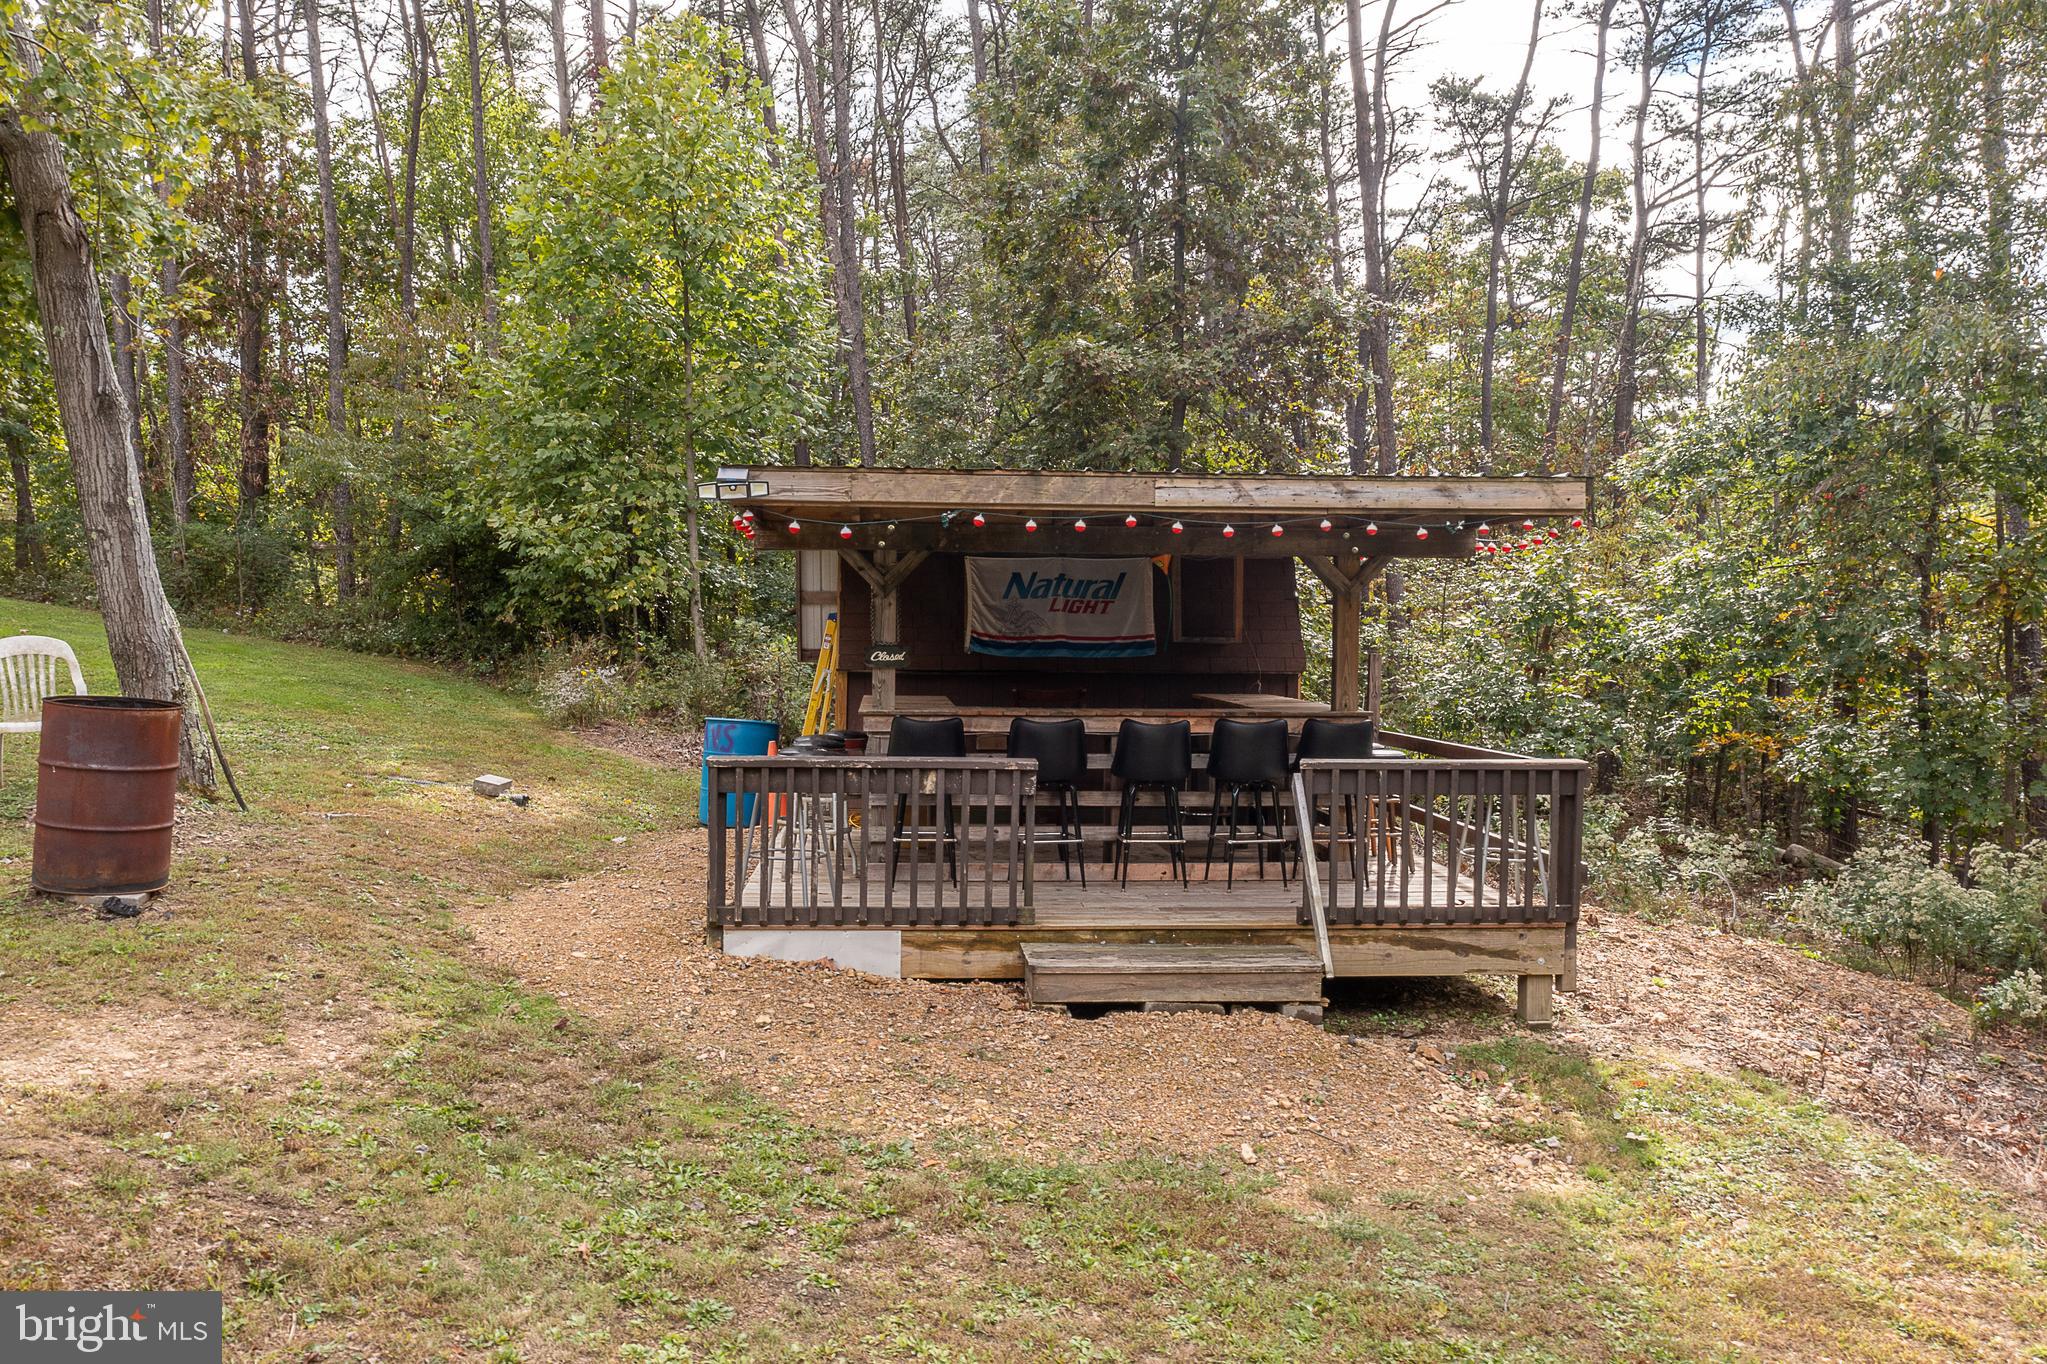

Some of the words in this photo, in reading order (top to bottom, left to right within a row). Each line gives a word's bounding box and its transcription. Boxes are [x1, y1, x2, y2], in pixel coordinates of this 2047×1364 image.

[1002, 571, 1127, 600] Natural
[1048, 600, 1116, 615] LIGHT
[870, 650, 906, 661] Closed
